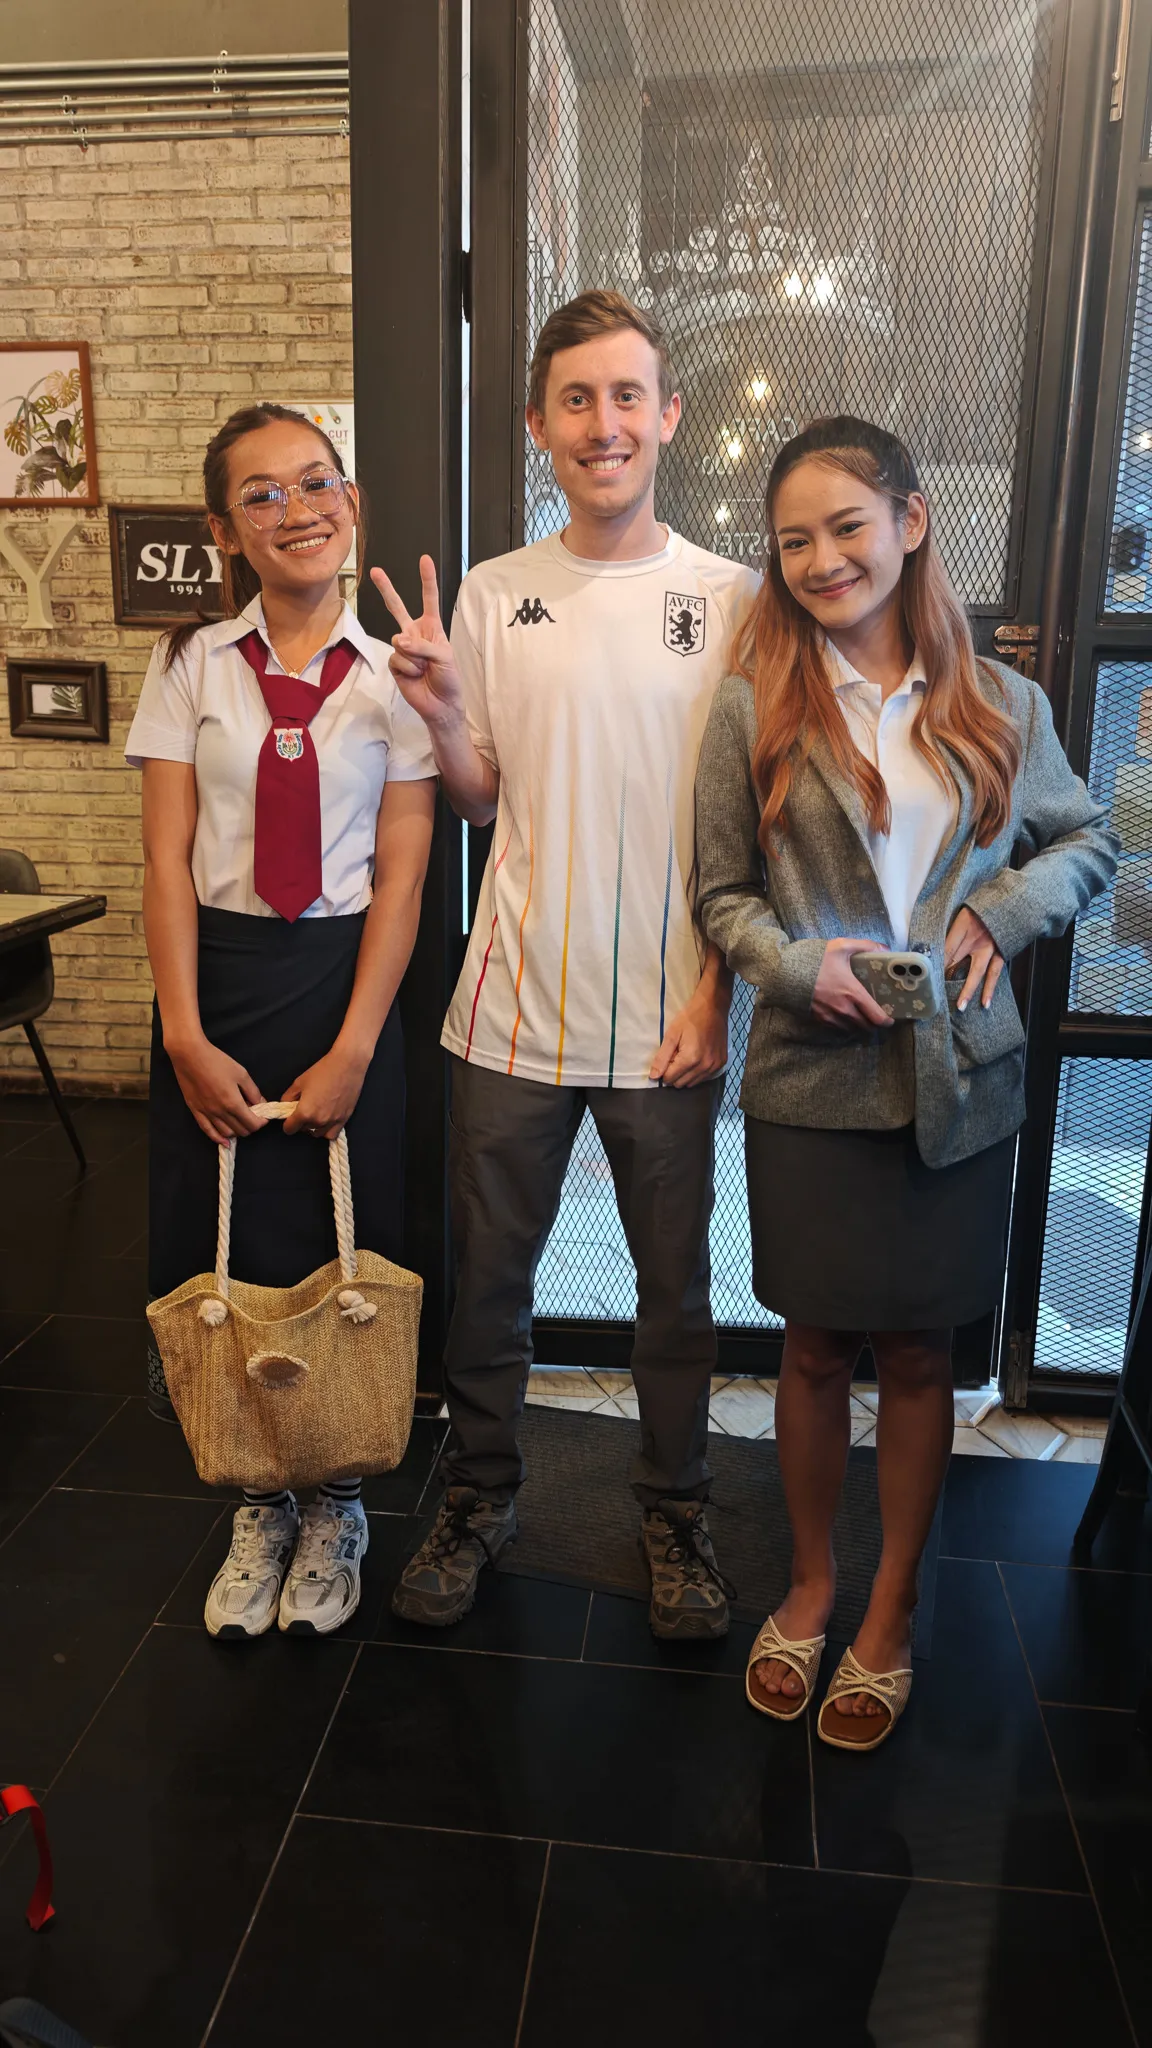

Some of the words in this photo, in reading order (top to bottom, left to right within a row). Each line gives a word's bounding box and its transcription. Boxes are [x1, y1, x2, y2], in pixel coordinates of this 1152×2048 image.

[328, 429, 348, 438] CUT
[136, 542, 223, 583] SLY
[169, 584, 203, 596] 1994
[668, 595, 703, 612] AVFC
